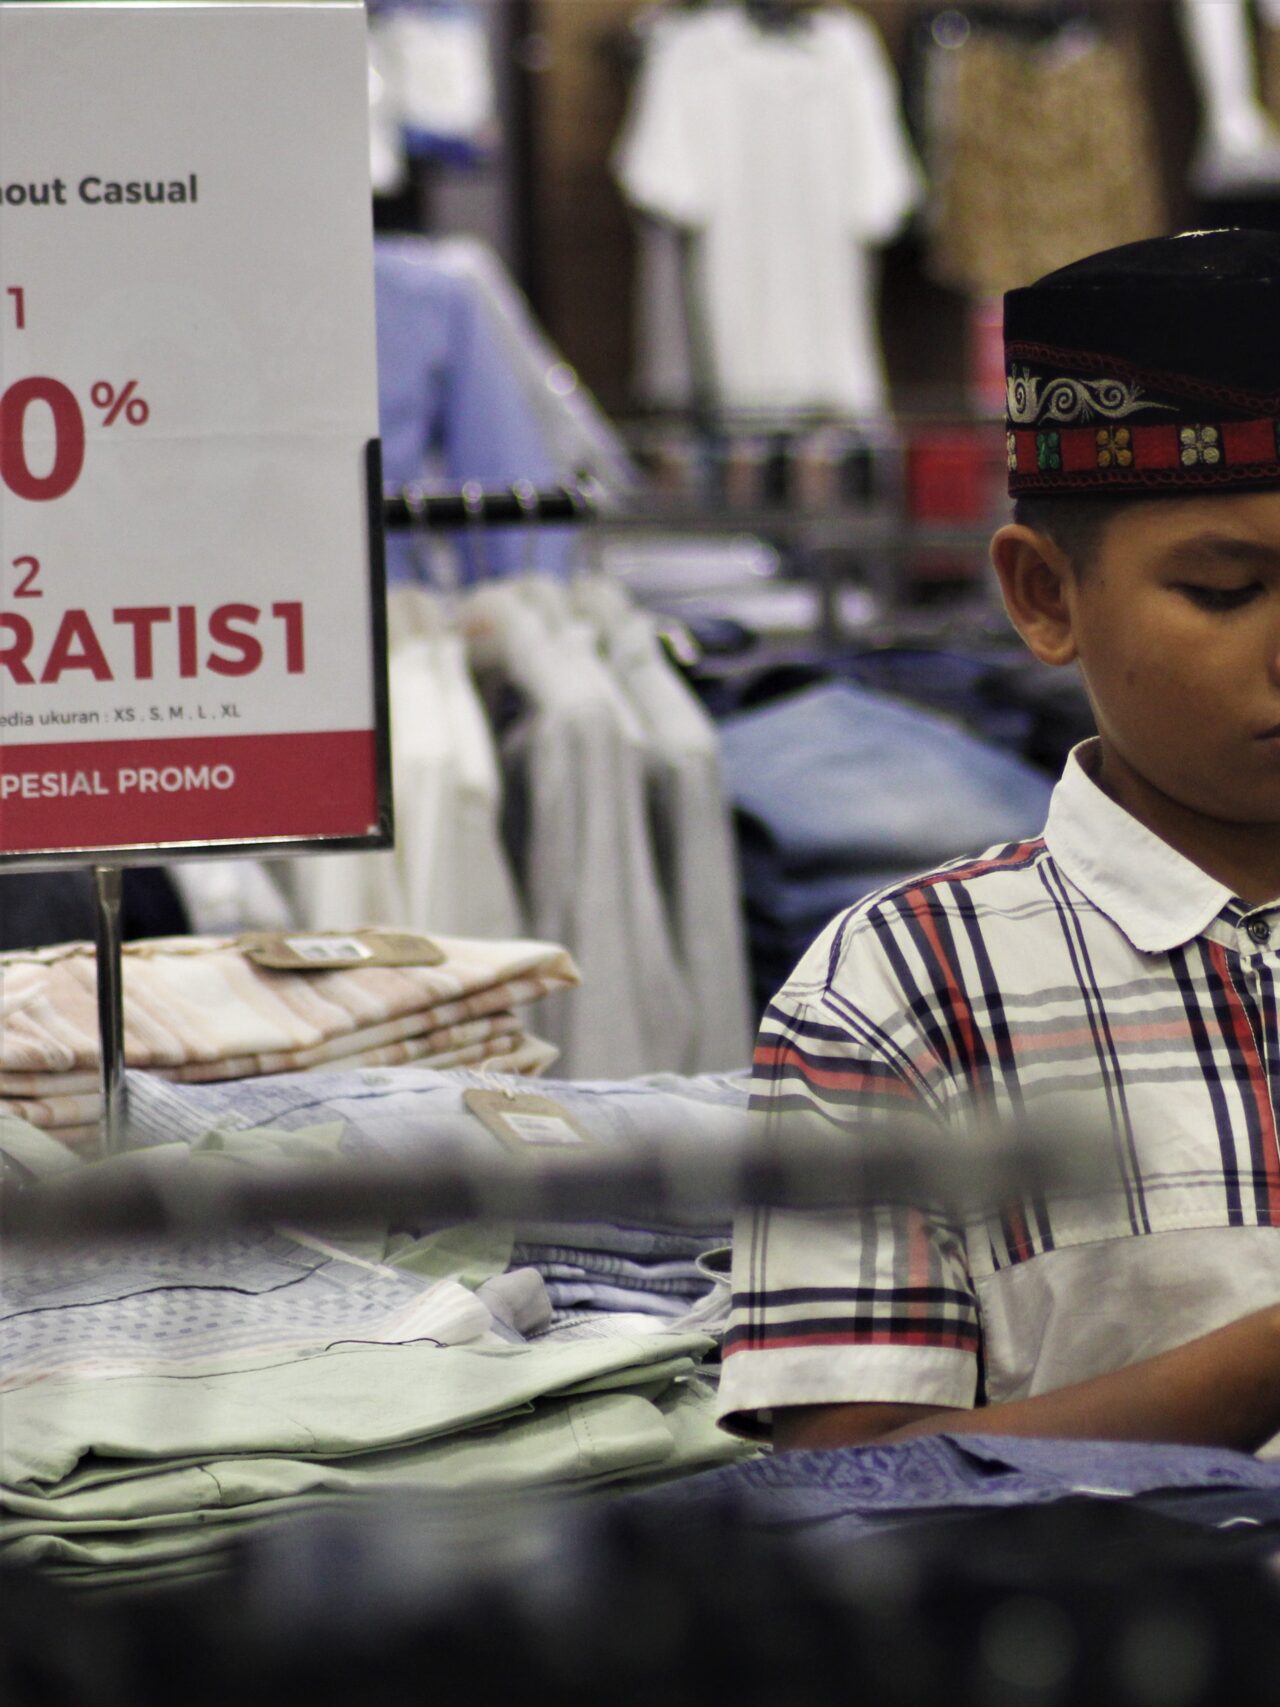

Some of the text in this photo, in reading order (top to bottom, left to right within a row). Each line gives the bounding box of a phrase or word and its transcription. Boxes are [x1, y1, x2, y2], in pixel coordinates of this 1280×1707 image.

[0, 173, 198, 206] out Casual
[7, 286, 26, 329] 1
[12, 555, 43, 598] 2
[39, 708, 100, 726] ukuran
[113, 707, 135, 723] XS
[169, 705, 183, 720] M
[221, 702, 241, 718] XL
[118, 764, 235, 794] PROMO
